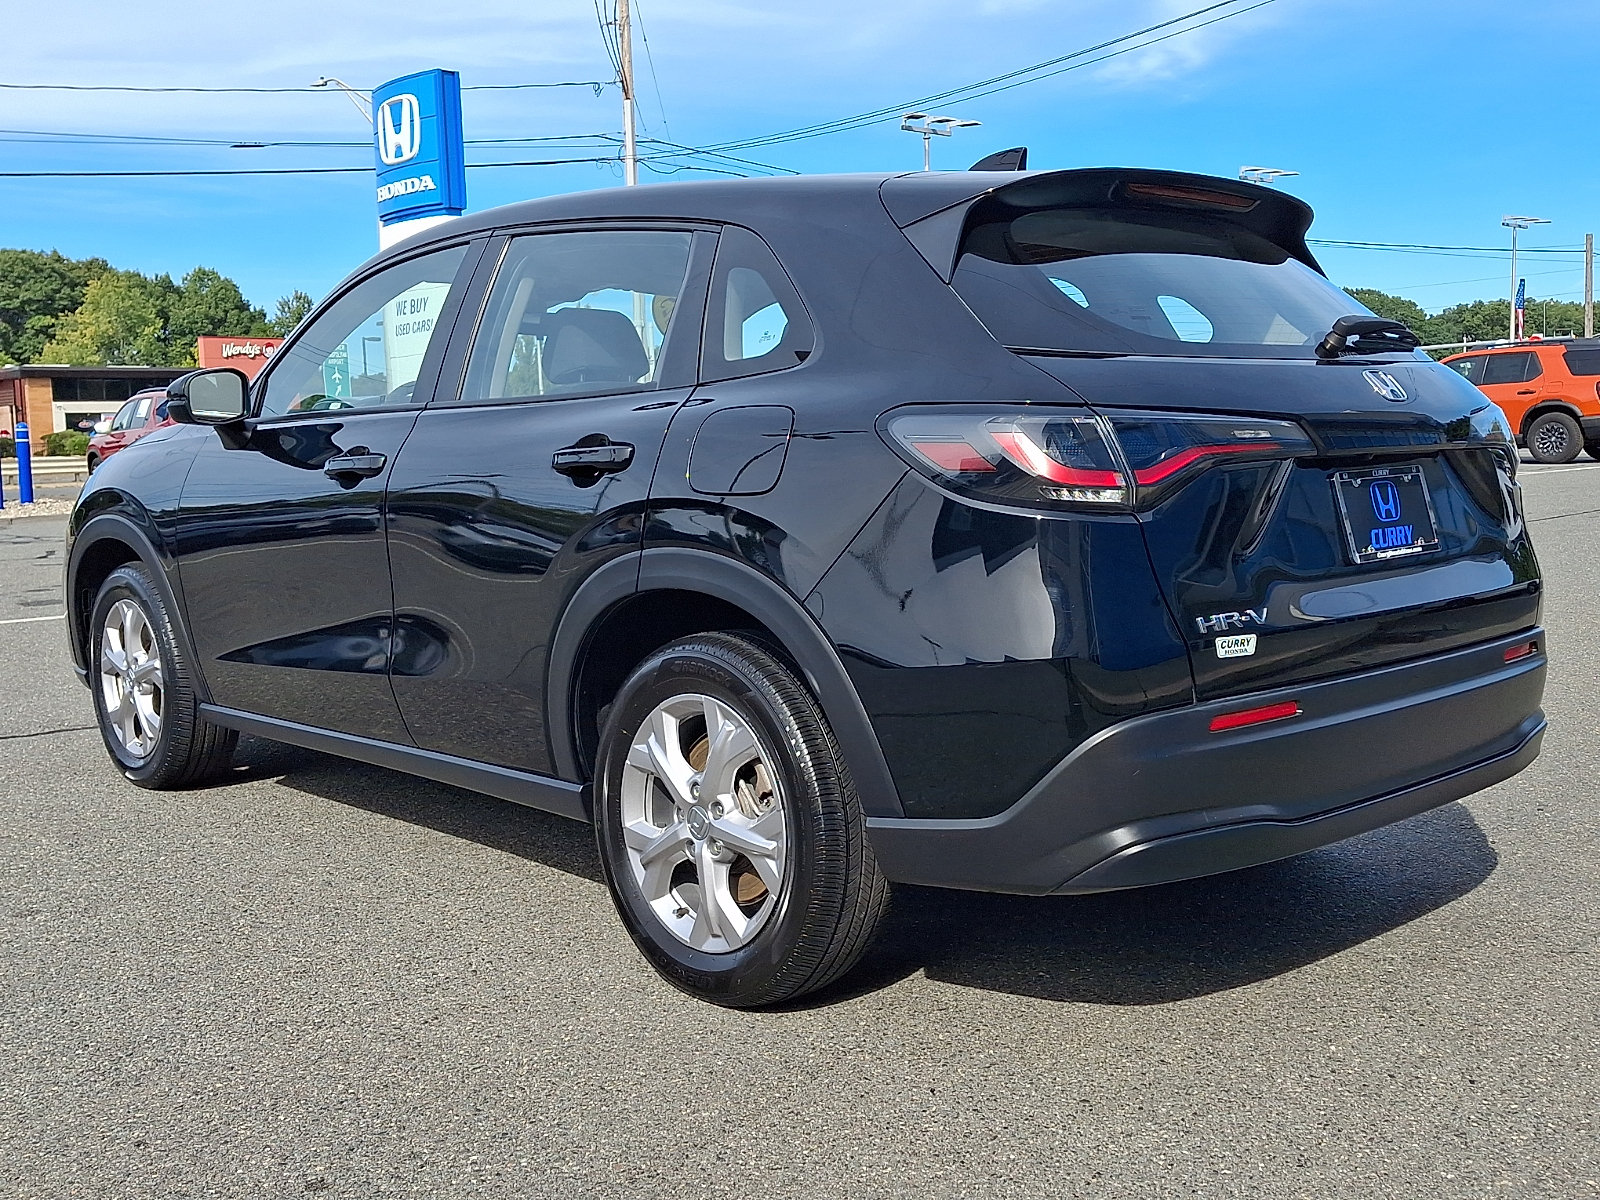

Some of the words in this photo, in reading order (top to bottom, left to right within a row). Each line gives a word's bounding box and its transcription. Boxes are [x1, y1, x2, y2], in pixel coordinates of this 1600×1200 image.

[376, 174, 437, 203] HONDA
[395, 300, 407, 316] WE
[410, 296, 429, 315] BUY
[395, 322, 410, 337] USED
[412, 318, 434, 334] CARS!
[222, 341, 260, 358] Wendy's
[1372, 469, 1390, 477] CURRY
[1371, 525, 1413, 549] CURRY
[1195, 607, 1268, 634] HR-V
[1220, 638, 1252, 650] CURRY
[1224, 648, 1249, 656] HONDA
